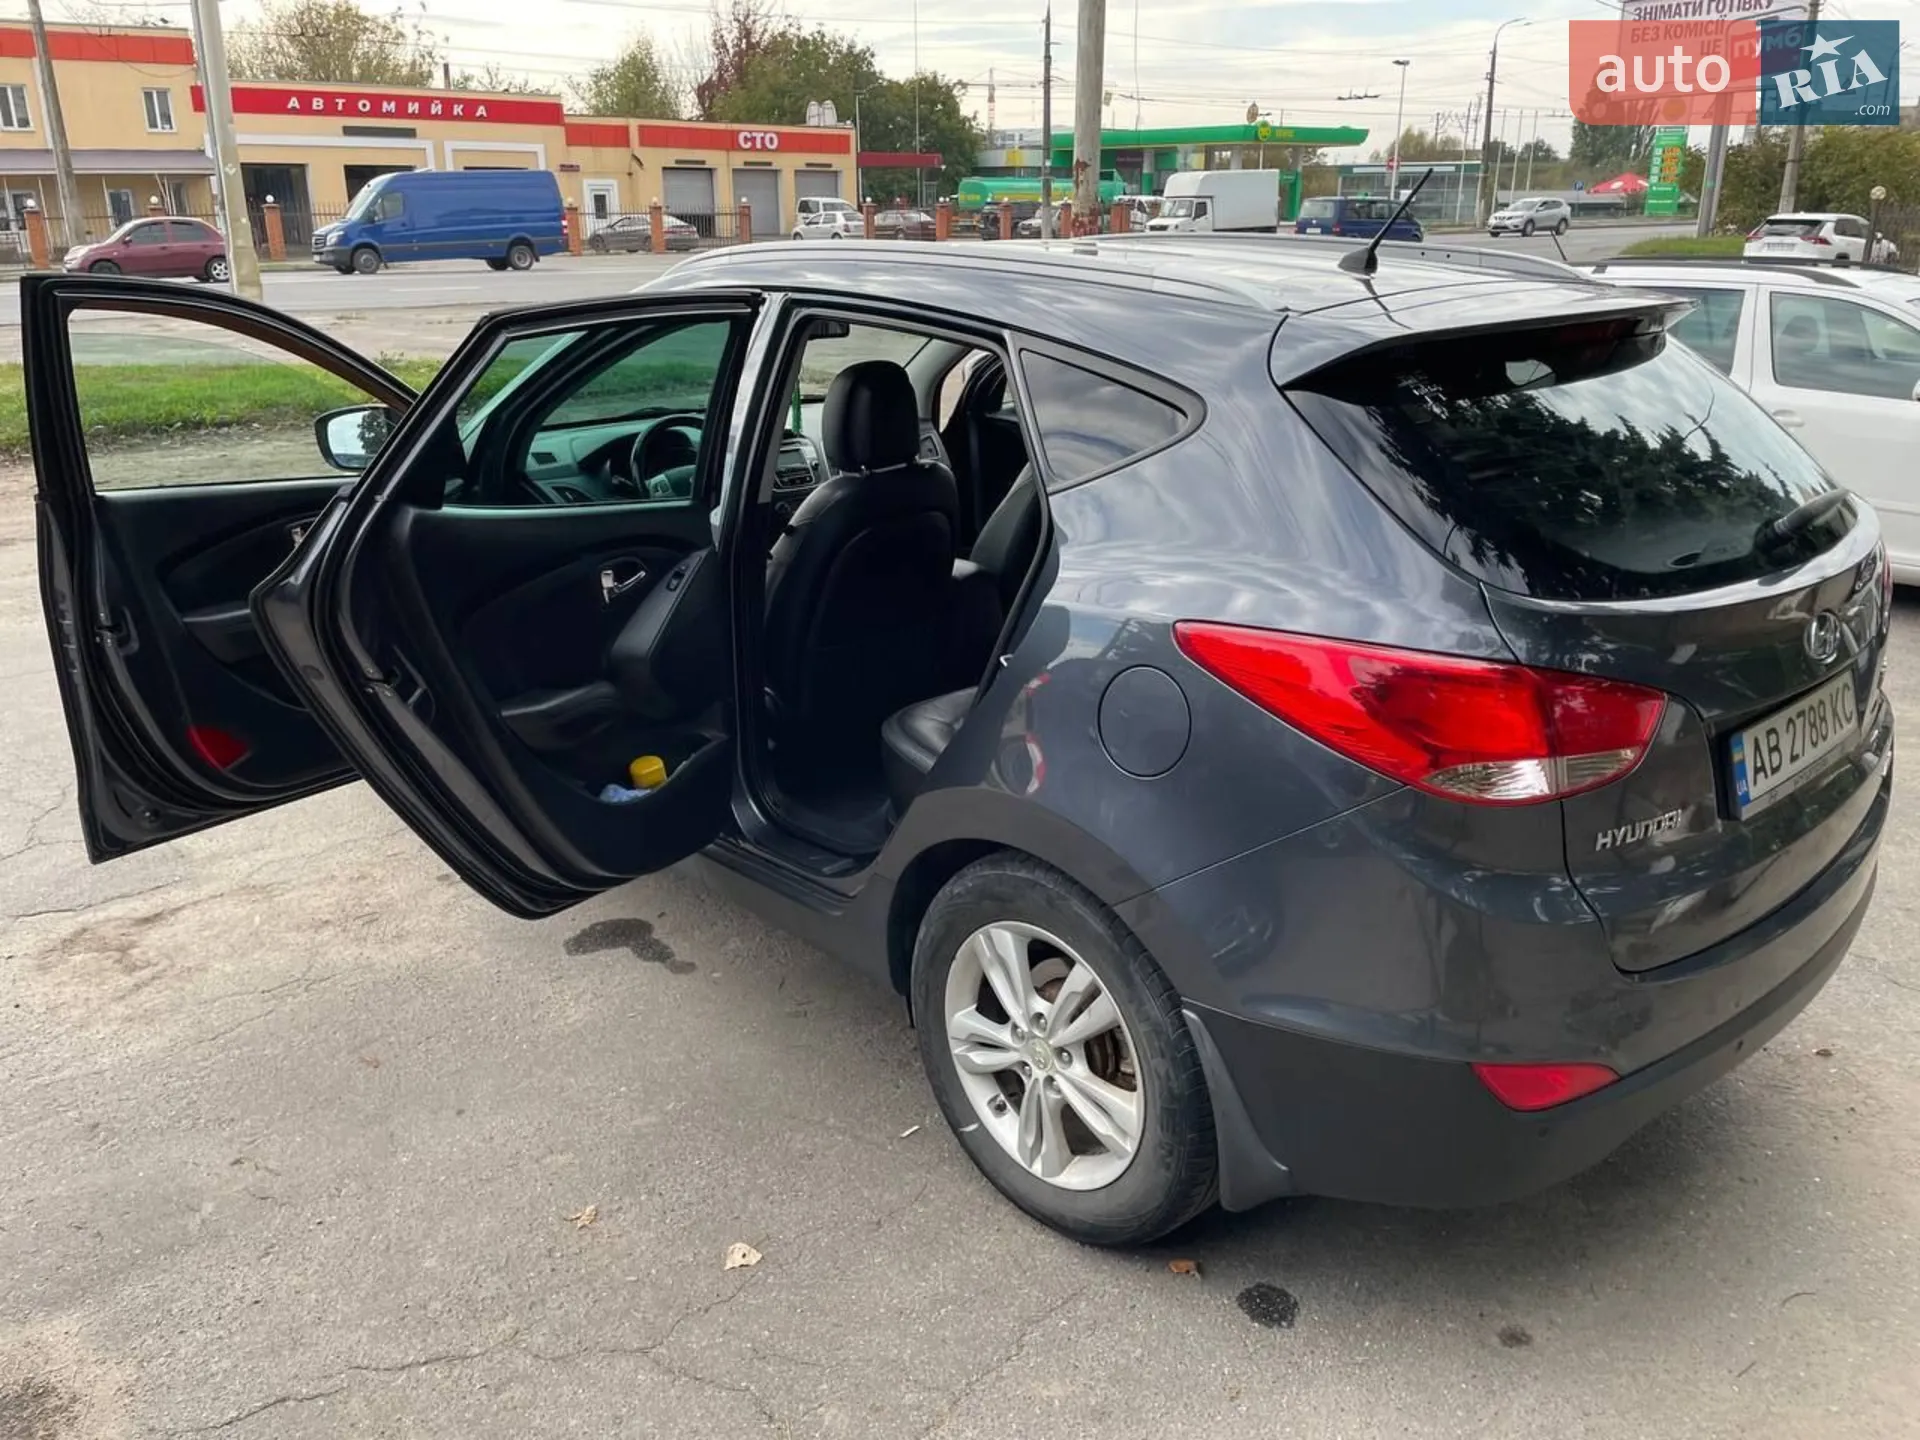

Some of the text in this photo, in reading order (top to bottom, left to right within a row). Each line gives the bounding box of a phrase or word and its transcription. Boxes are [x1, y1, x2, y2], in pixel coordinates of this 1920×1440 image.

[1632, 1, 1703, 23] ЗНІМАТИ
[1630, 27, 1660, 44] БЕЗ
[286, 96, 489, 118] АВТОМИЙКА
[737, 130, 779, 151] СТО
[1785, 697, 1829, 766] 2788
[1595, 808, 1683, 852] HYUNDAI
